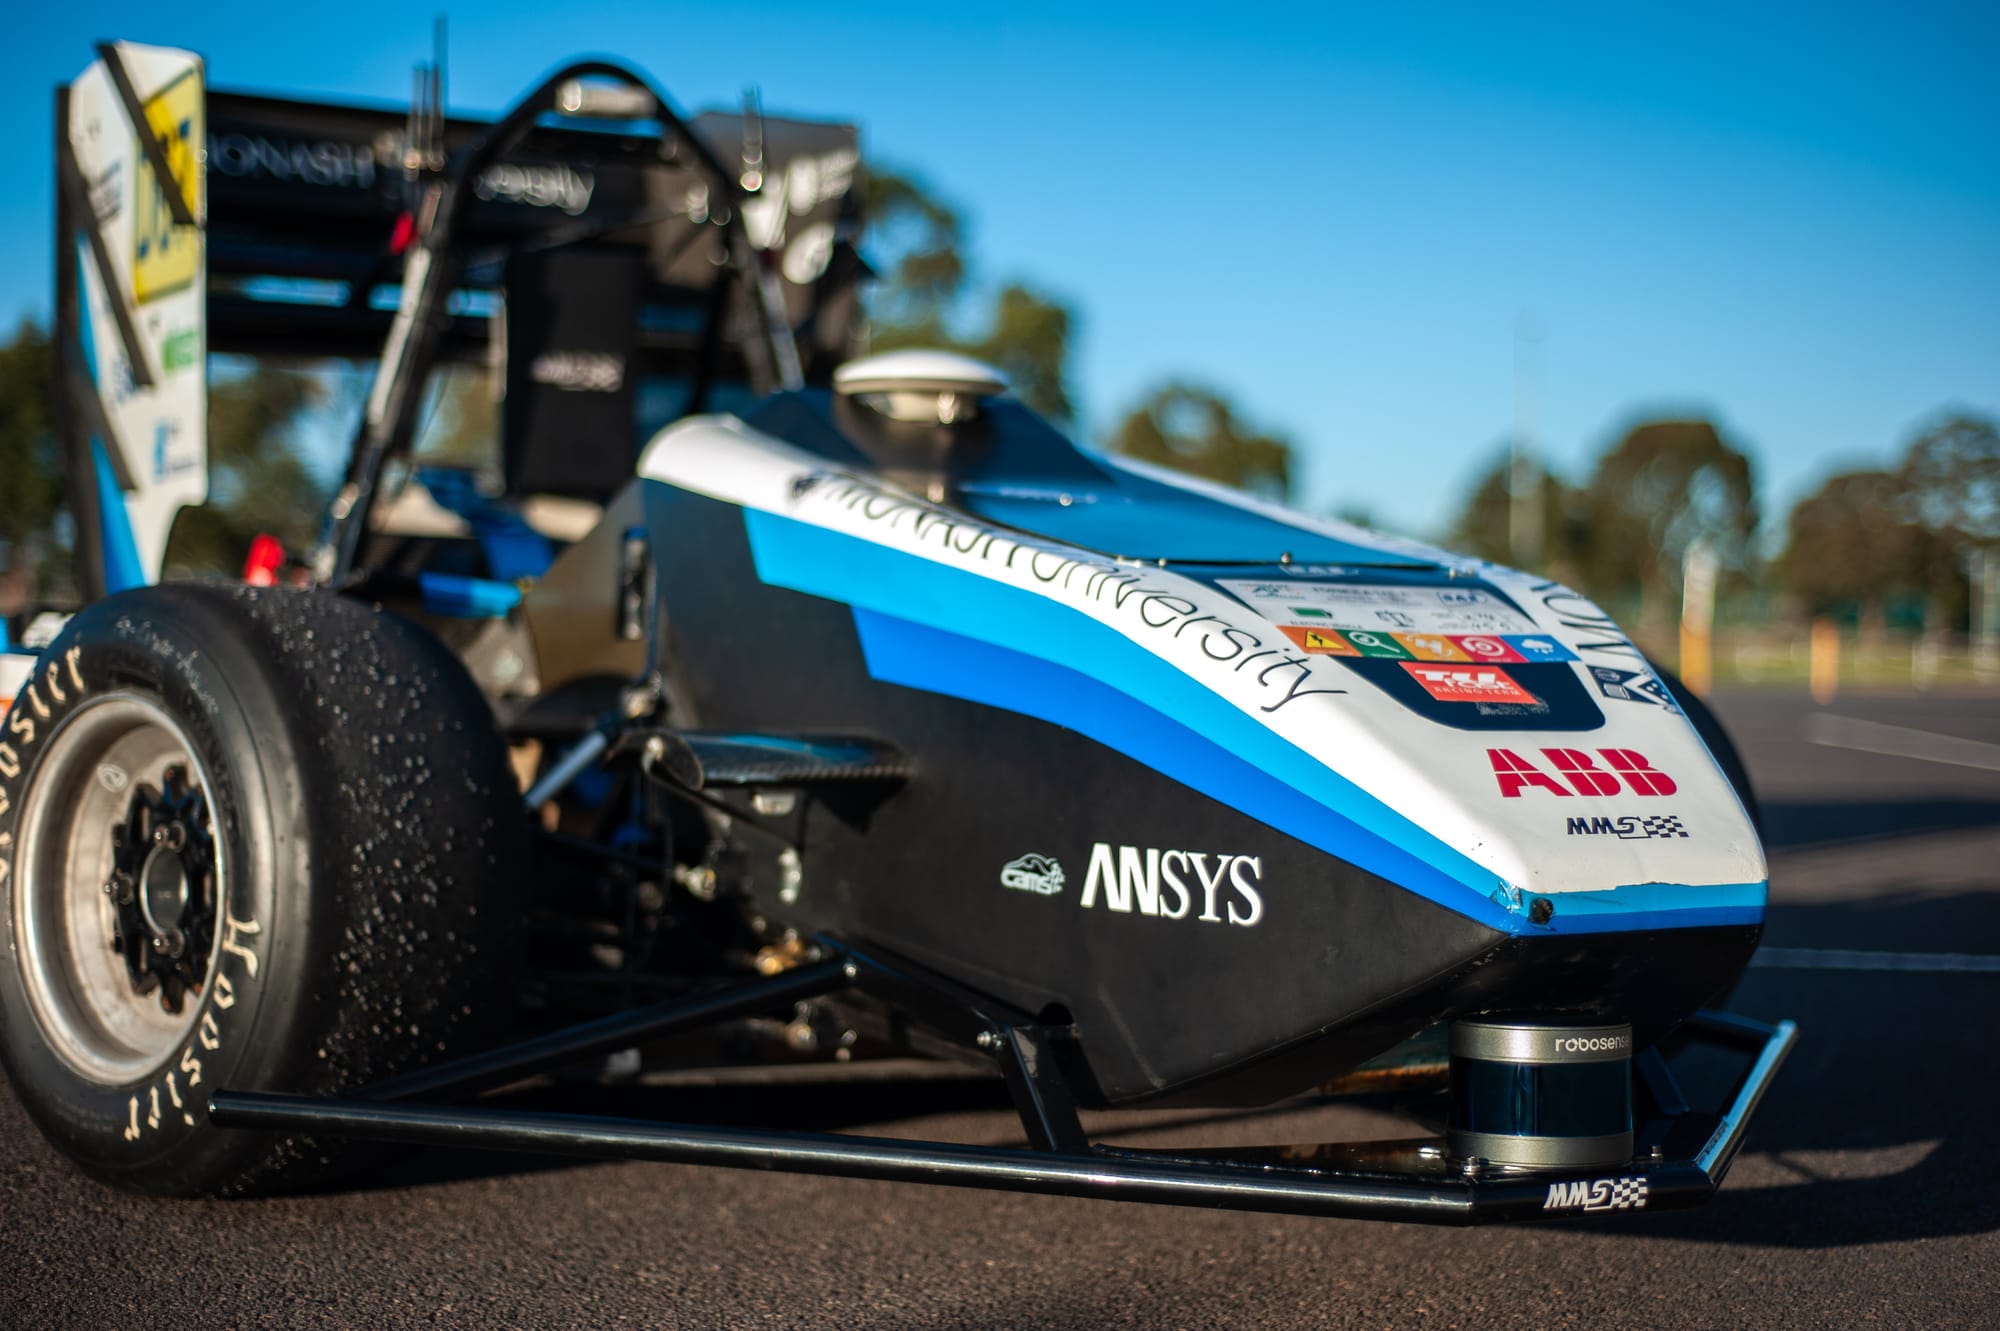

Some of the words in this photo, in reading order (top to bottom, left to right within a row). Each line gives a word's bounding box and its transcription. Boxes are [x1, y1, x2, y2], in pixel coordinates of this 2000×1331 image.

[206, 133, 377, 190] ONASH
[1031, 551, 1348, 712] University
[1486, 748, 1677, 797] ABB
[1080, 842, 1263, 927] ANSYS
